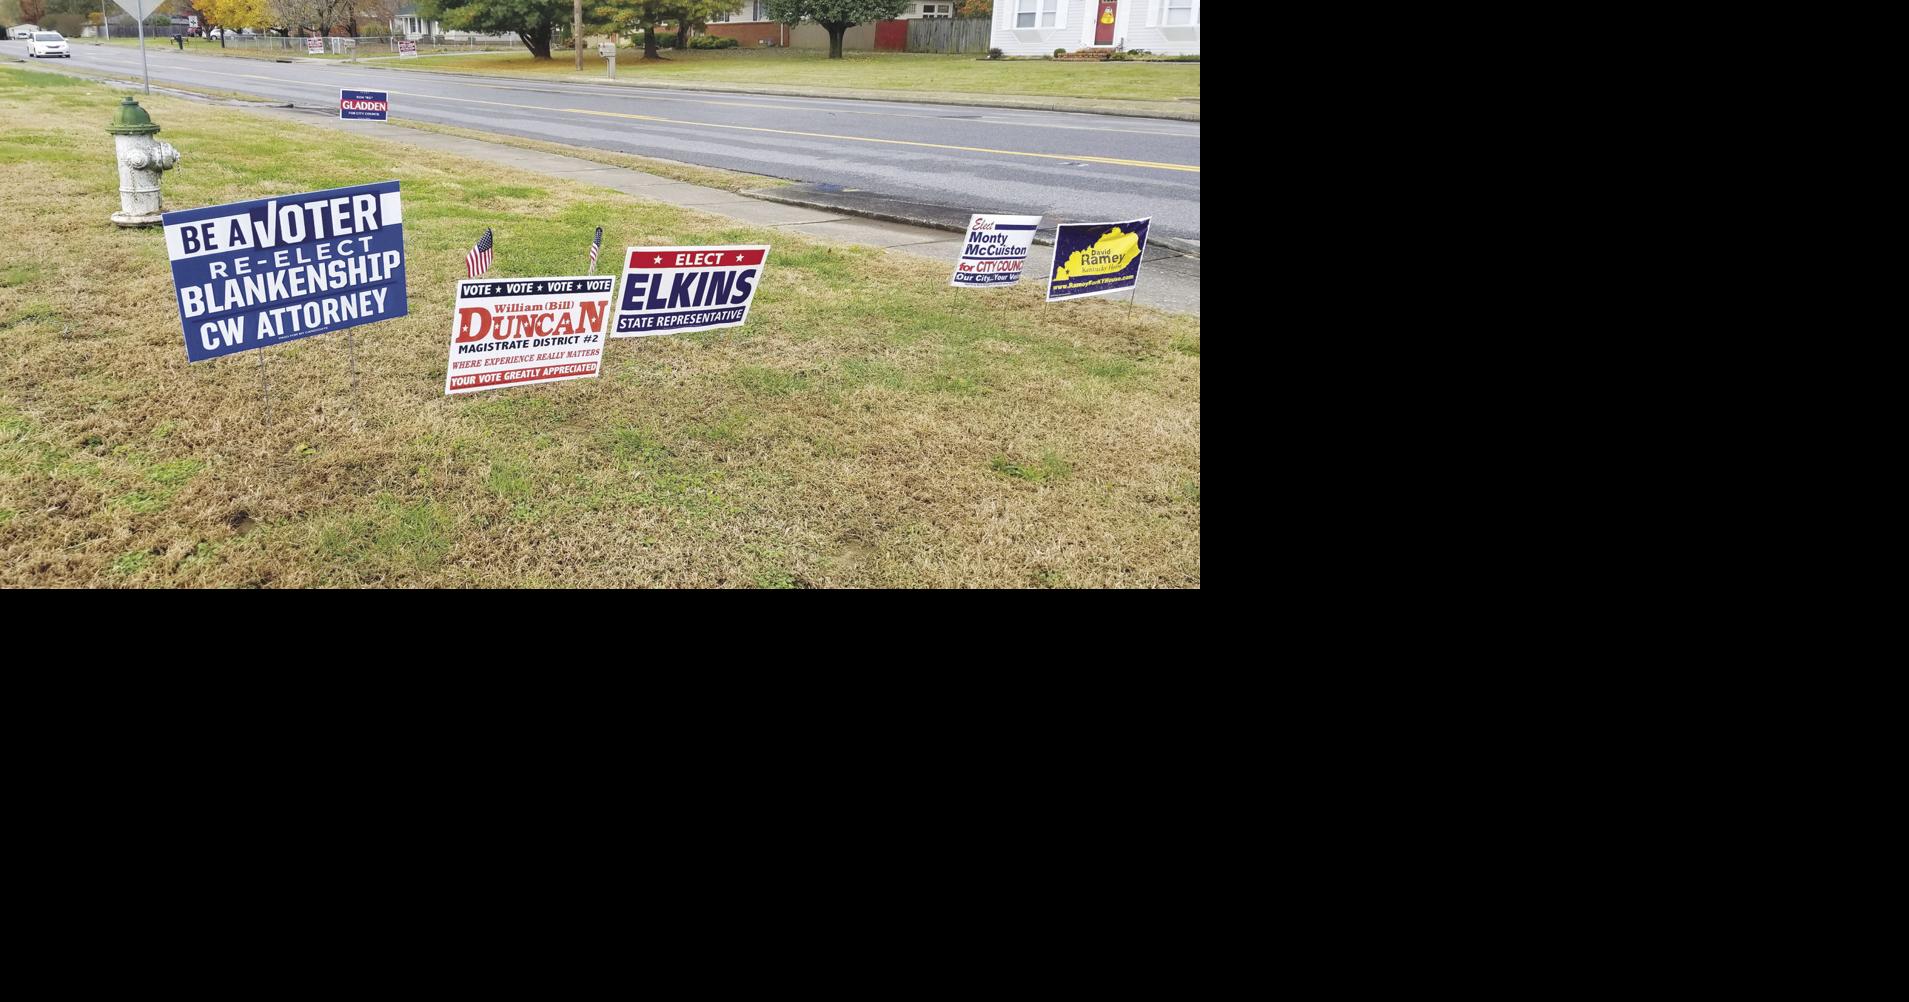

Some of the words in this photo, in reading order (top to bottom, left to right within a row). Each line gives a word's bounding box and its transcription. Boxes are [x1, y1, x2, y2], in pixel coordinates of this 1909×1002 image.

[342, 100, 386, 111] GLADDEN
[180, 222, 218, 254] BE
[229, 219, 247, 247] A
[254, 193, 379, 249] VOTER
[972, 218, 994, 231] Elect
[969, 232, 1008, 246] Monty
[209, 235, 373, 279] RE-ELECT
[675, 252, 725, 266] ELECT
[964, 244, 1027, 256] McCuiston
[959, 262, 975, 272] for
[976, 261, 998, 272] CITY
[1081, 254, 1125, 265] Ramey
[180, 250, 401, 318] BLANKENSHIP
[956, 273, 975, 281] Our
[463, 284, 492, 296] VOTE
[506, 283, 534, 294] VOTE
[547, 281, 573, 292] VOTE
[586, 280, 611, 291] VOTE
[621, 268, 757, 311] ELKINS
[494, 303, 543, 313] William
[545, 300, 575, 311] (Bill)
[200, 316, 245, 351] CW
[256, 287, 388, 340] ATTORNEY
[455, 300, 609, 343] DUNCAN
[619, 316, 653, 329] STATE
[656, 308, 744, 327] REPRESENTATIVE
[458, 339, 530, 354] MAGISTRATE
[533, 335, 580, 348] DISTRICT
[583, 334, 599, 344] #2
[452, 359, 482, 370] WHERE
[484, 354, 535, 367] EXPERIENCE
[536, 351, 565, 361] REALLY
[566, 349, 600, 358] MATTERS
[451, 375, 476, 387] YOUR
[479, 372, 502, 383] VOTE
[504, 368, 541, 380] GREATLY
[542, 362, 597, 376] APPRECIATED
